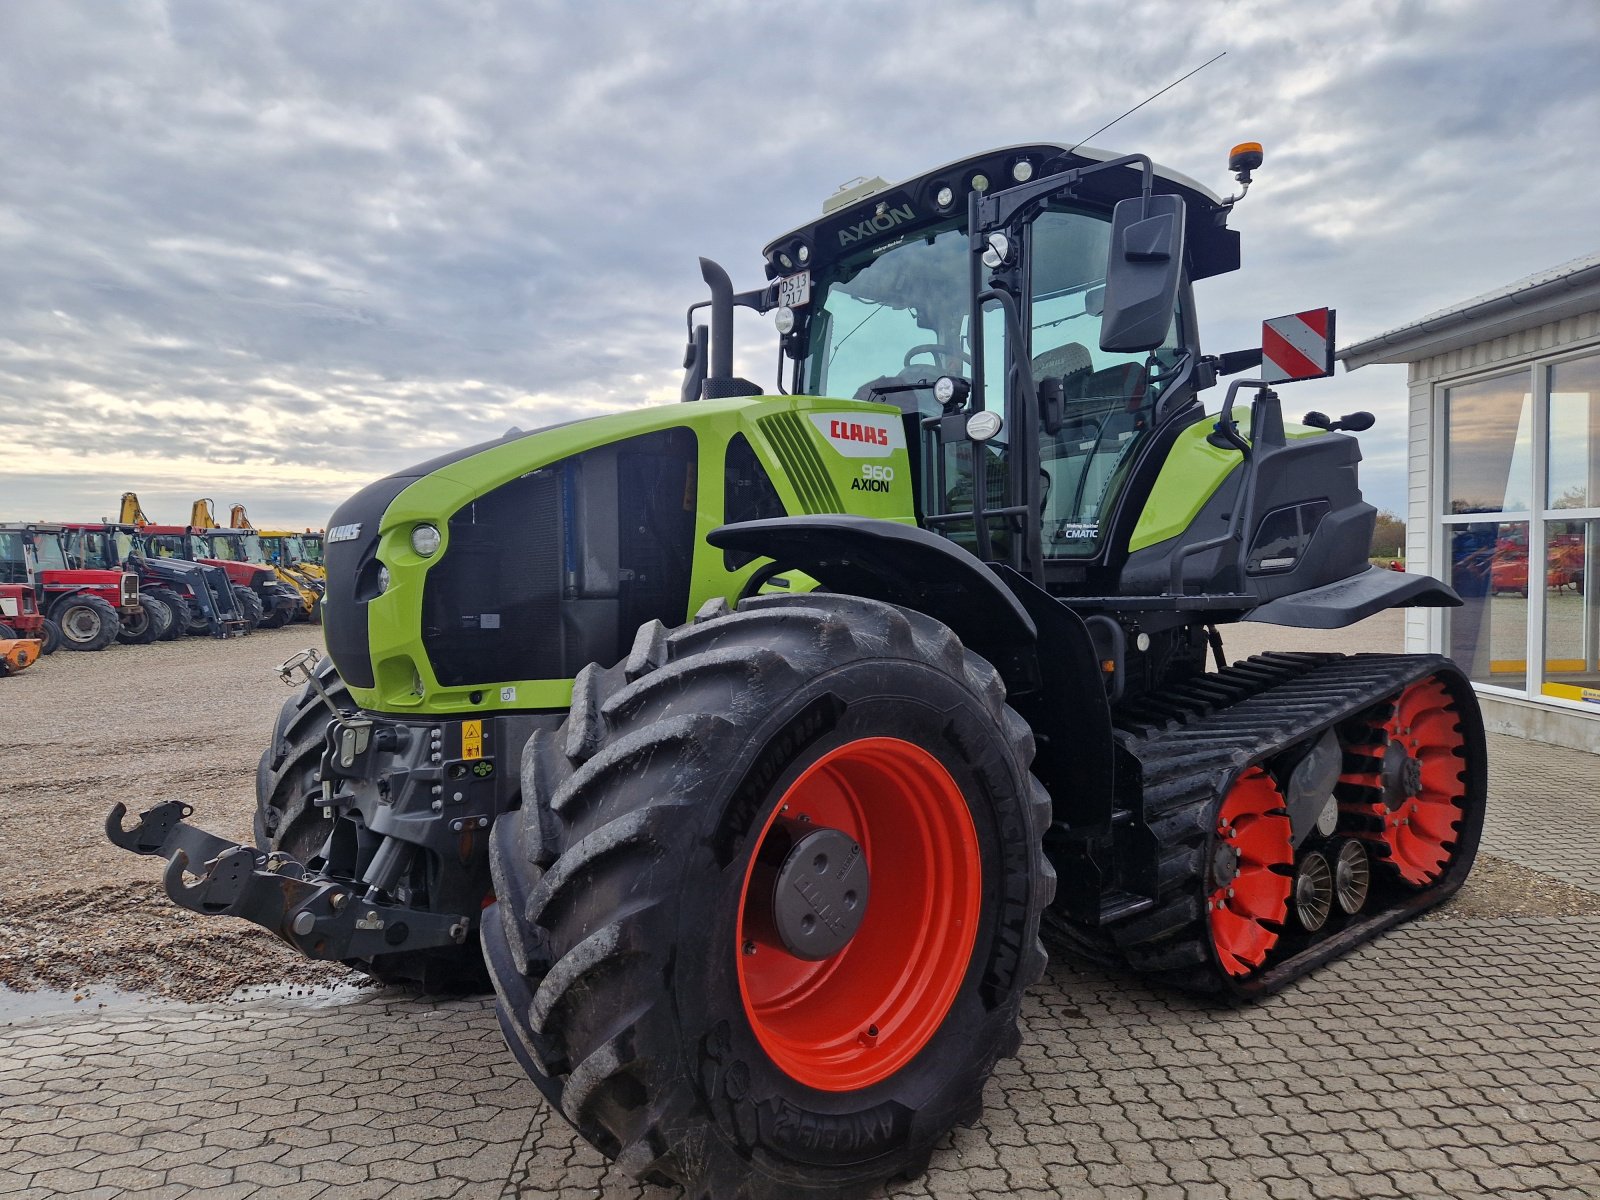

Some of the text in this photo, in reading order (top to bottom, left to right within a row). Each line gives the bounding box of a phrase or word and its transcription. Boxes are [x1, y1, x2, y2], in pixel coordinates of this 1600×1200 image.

[837, 203, 916, 246] AXION
[786, 289, 803, 306] 217
[830, 420, 888, 446] CLAAS
[862, 464, 894, 481] 960
[851, 478, 889, 493] AXION
[1065, 529, 1099, 538] CMATIC
